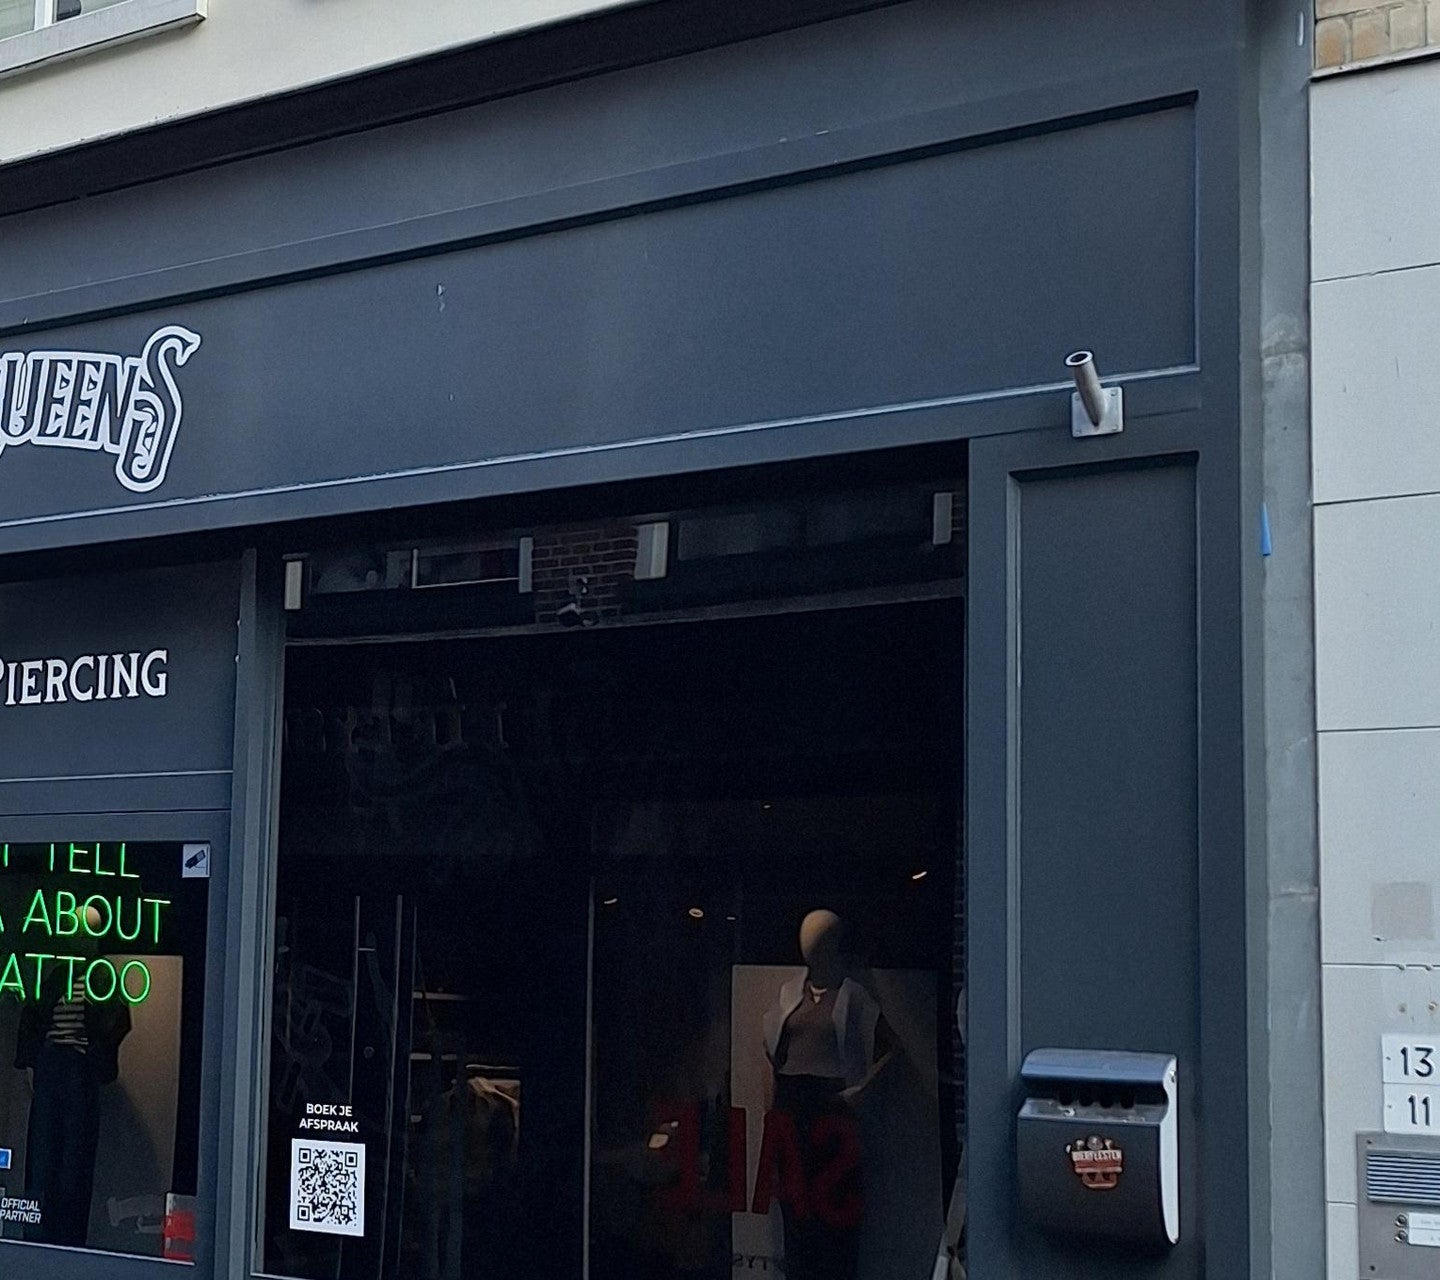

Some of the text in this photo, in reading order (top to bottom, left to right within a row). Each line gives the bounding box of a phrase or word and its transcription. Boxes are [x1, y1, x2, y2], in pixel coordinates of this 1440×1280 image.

[21, 888, 172, 944] ABOUT
[1400, 1046, 1435, 1078] 13
[306, 1103, 353, 1117] BOEK JE
[1408, 1095, 1431, 1126] 11
[299, 1118, 359, 1133] AFSPRAAK
[0, 1197, 41, 1212] OFFICIAL
